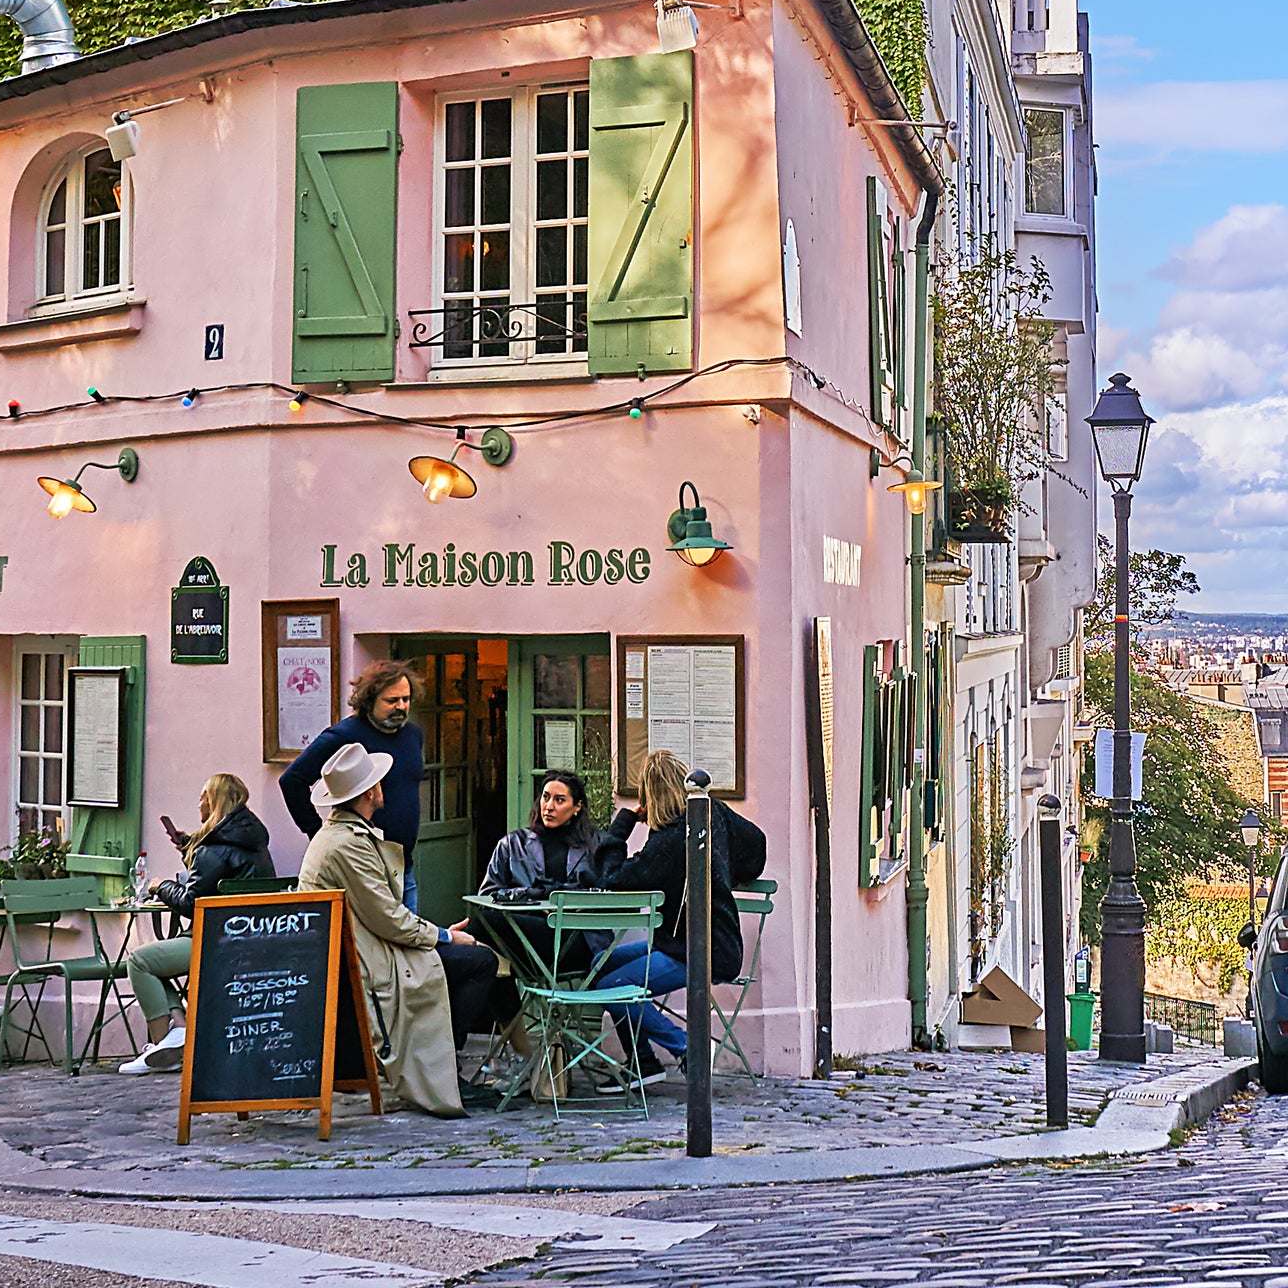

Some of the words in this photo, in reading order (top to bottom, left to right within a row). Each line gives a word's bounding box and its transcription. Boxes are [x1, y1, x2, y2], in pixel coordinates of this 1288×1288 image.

[208, 327, 220, 358] 2
[320, 544, 370, 588] La
[381, 543, 535, 588] Maison
[547, 541, 651, 587] Rose
[192, 608, 204, 620] RUE
[175, 624, 183, 635] DE
[184, 624, 223, 636] L'ABREUVOIR
[224, 912, 321, 935] OUVERT
[224, 974, 310, 996] BOISSONS
